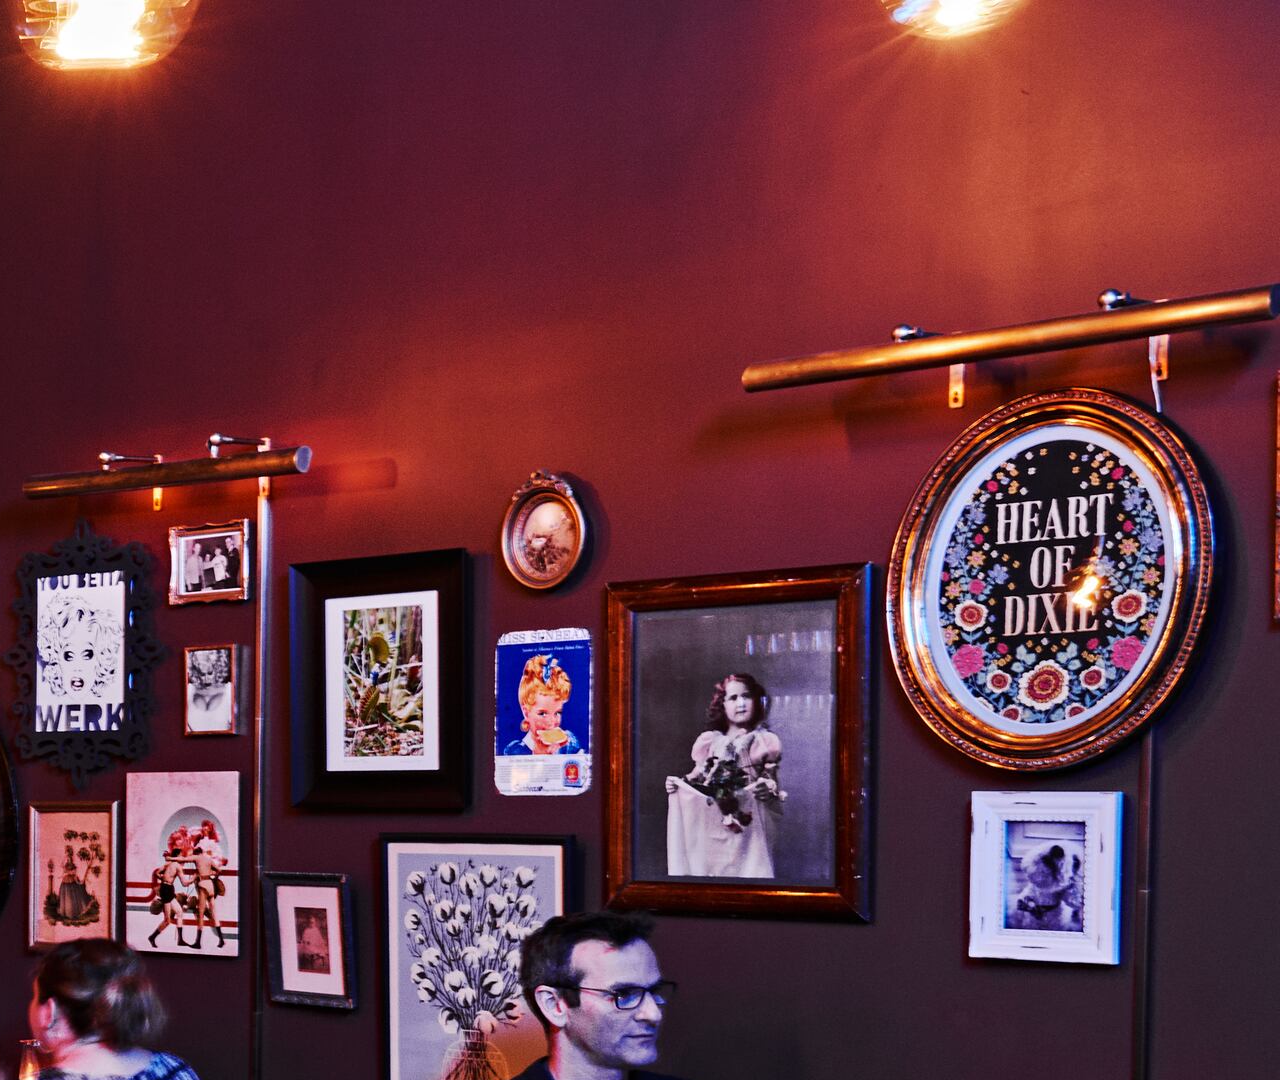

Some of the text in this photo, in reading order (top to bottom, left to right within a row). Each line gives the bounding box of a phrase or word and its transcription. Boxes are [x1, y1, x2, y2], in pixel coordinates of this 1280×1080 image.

[995, 493, 1115, 545] HEART
[39, 576, 70, 591] YOU
[1029, 545, 1076, 588] OF
[1002, 591, 1100, 637] DIXIE
[36, 703, 125, 732] WERK
